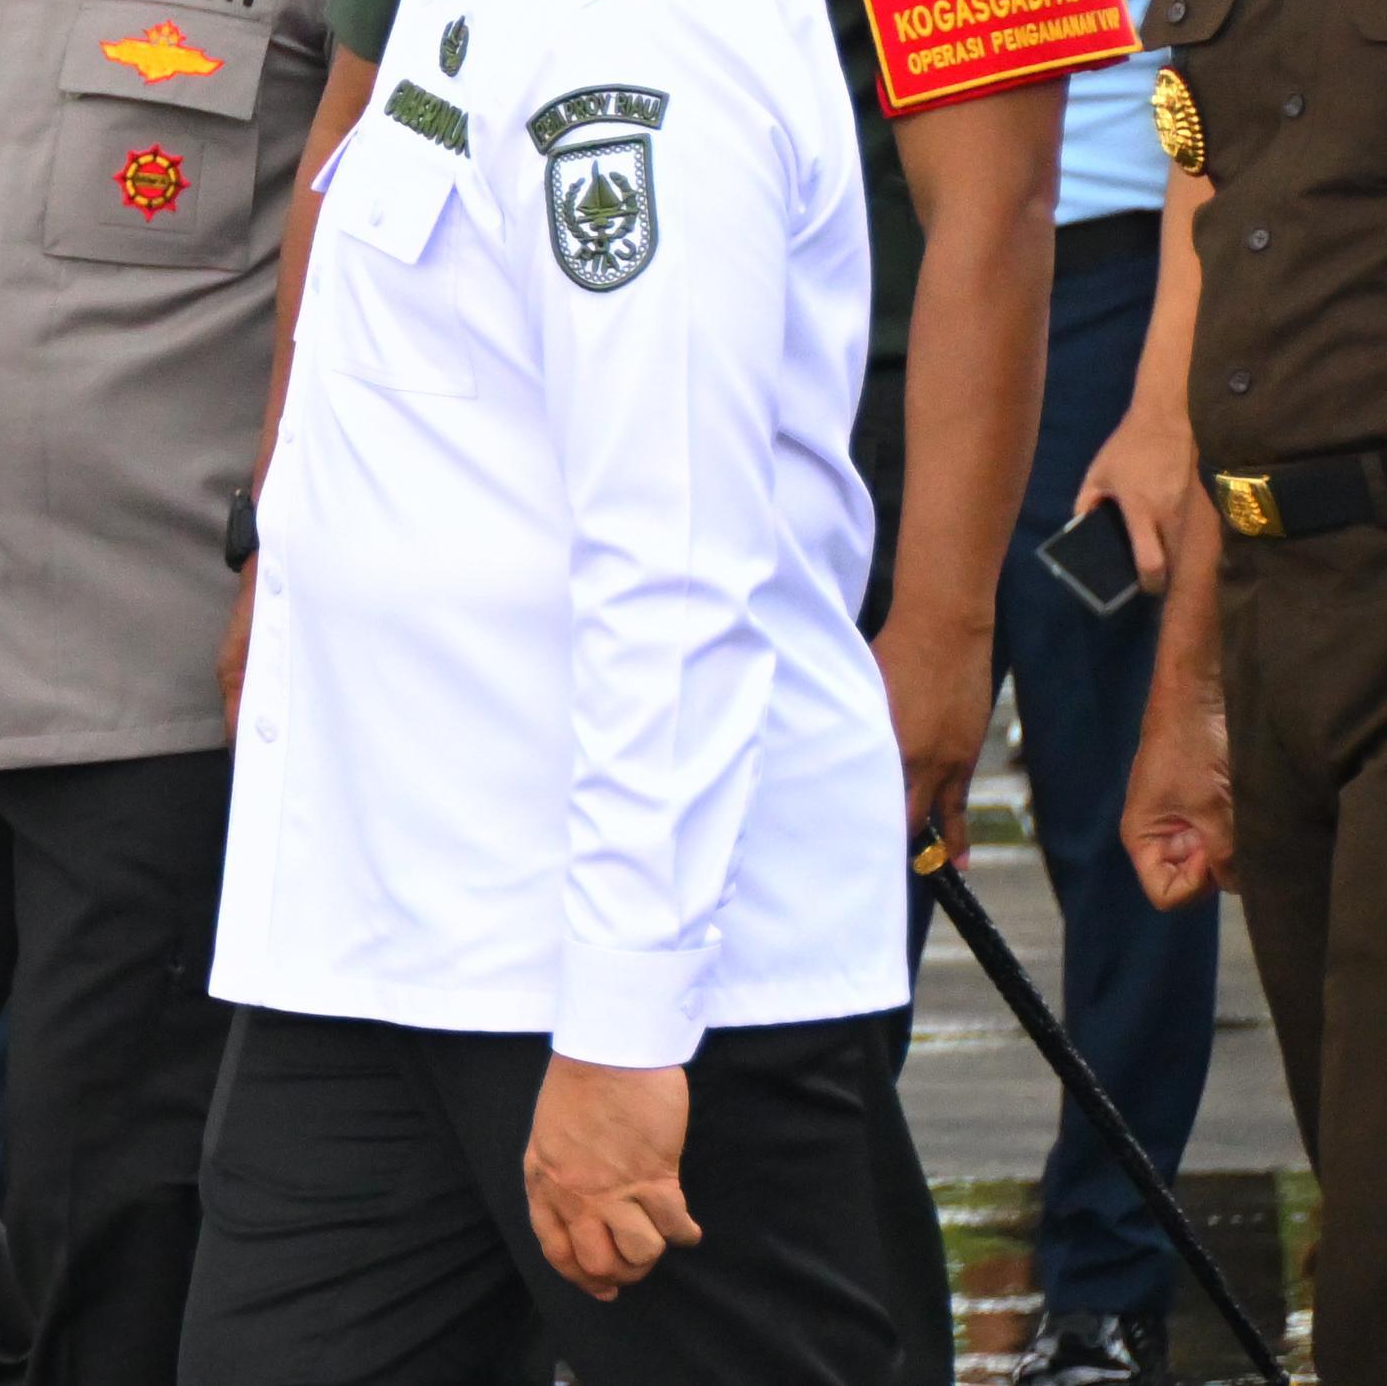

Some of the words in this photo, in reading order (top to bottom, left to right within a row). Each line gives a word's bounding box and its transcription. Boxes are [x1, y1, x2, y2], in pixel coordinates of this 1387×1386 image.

[907, 36, 985, 75] OPERASI
[990, 10, 1098, 55] PENGAMANAN
[563, 93, 612, 124] PROV
[615, 91, 660, 120] RIAU
